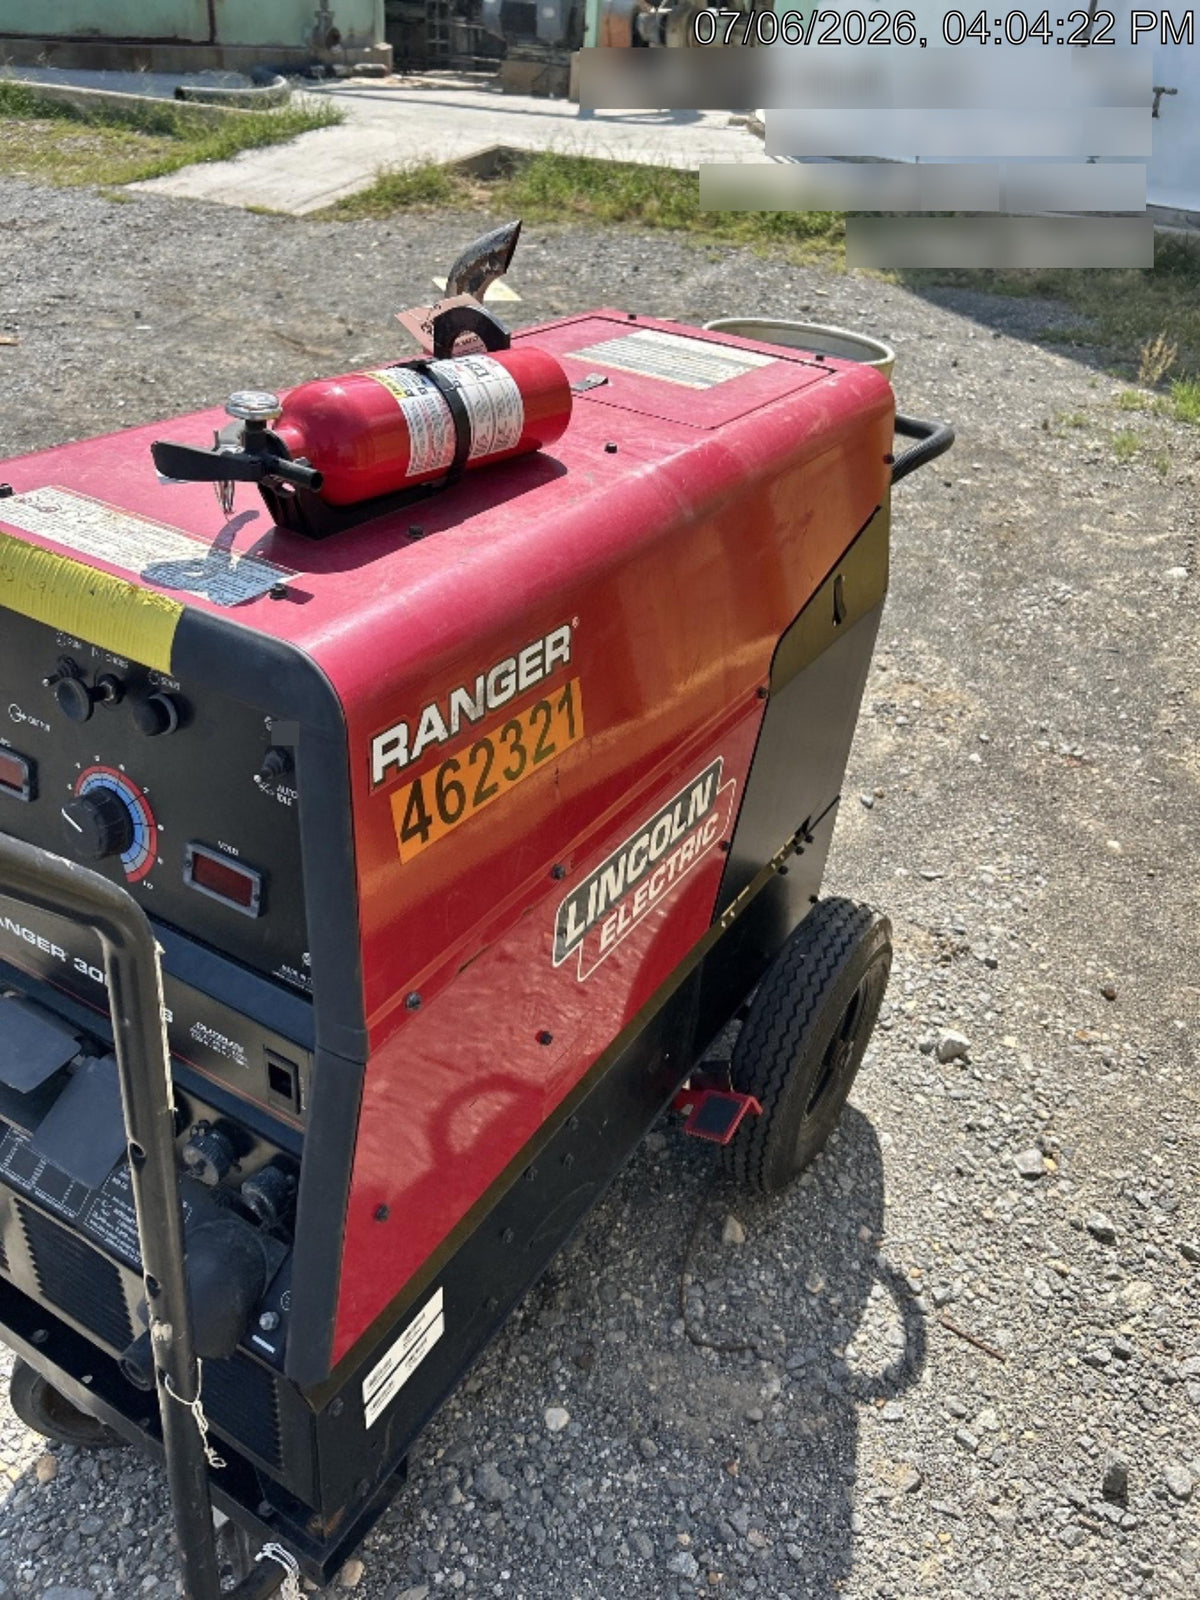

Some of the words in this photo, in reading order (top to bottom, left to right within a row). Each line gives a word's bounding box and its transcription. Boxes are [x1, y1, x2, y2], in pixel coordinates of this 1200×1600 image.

[370, 623, 573, 786] RANGER
[400, 682, 577, 844] 462321
[564, 772, 715, 948] LINCOLN
[599, 813, 719, 953] ELECTRIC
[73, 957, 110, 988] 30
